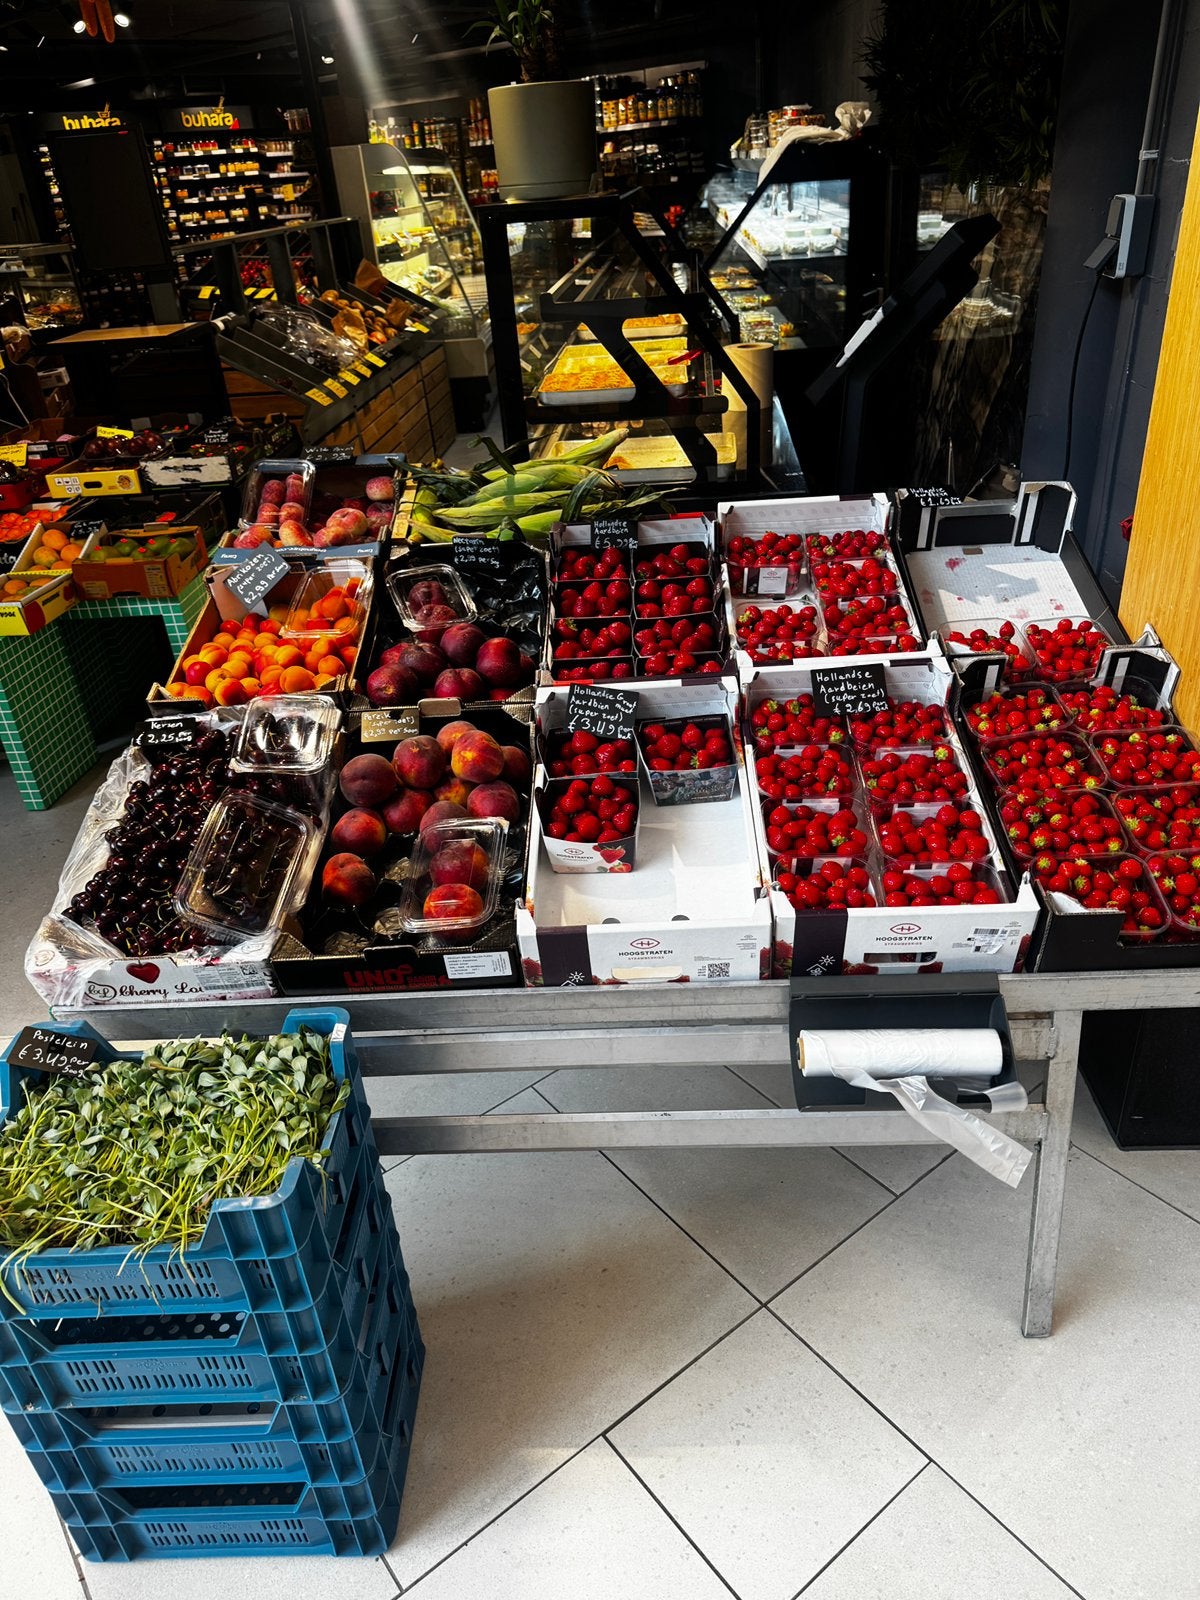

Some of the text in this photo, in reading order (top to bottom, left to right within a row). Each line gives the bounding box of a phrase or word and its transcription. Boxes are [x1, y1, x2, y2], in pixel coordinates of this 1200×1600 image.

[181, 111, 233, 128] buhara
[226, 552, 265, 588] Abrikozen
[815, 669, 873, 683] Hollandse
[573, 684, 616, 700] Hollandse
[819, 681, 875, 694] Aardbeien
[824, 688, 885, 704] (super zoet)
[569, 704, 623, 722] (super zoet)
[151, 721, 183, 730] Kersen
[618, 949, 674, 957] HOOGSTRATEN
[118, 984, 170, 999] Cherry
[32, 1029, 88, 1050] Postelein
